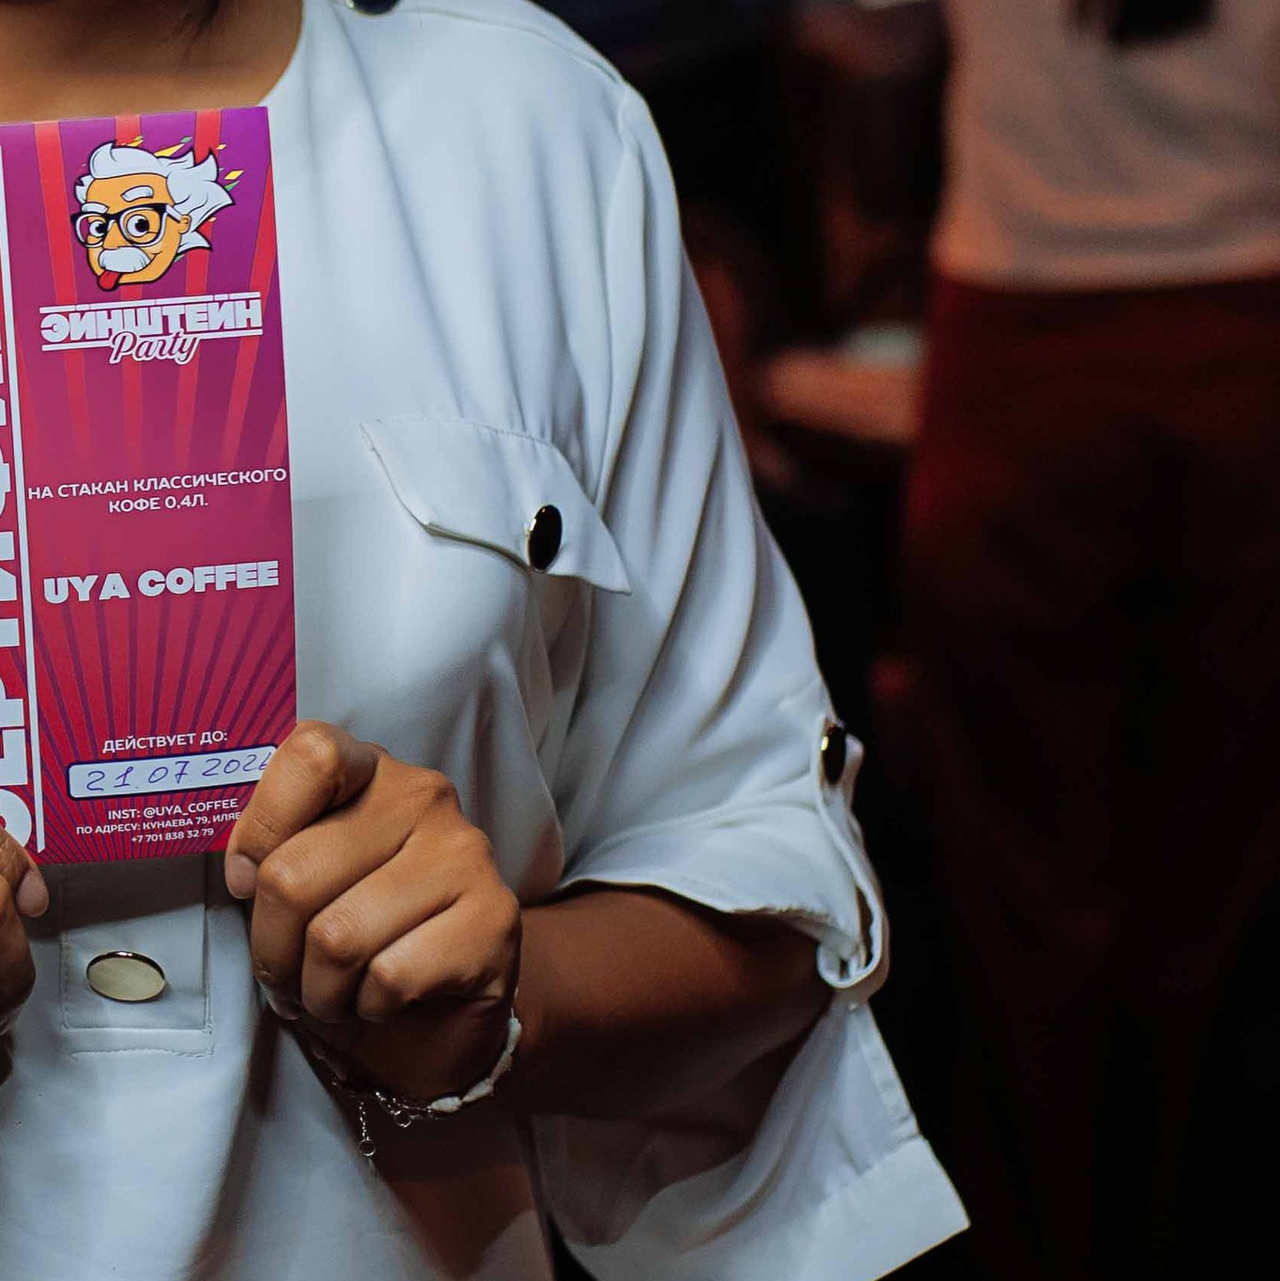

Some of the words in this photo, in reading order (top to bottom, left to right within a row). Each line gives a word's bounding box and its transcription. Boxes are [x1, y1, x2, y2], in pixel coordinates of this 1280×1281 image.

[109, 329, 202, 365] Party
[28, 486, 53, 500] НА
[57, 480, 129, 498] СТАКАН
[133, 468, 288, 492] КЛАССИЧЕСКОГО
[108, 497, 161, 513] КОФЕ
[43, 572, 131, 604] UYA
[137, 560, 279, 598] COFFEE
[102, 733, 196, 753] ДЕЙСТВУЕТ
[199, 730, 228, 745] ДО:
[108, 808, 141, 820] INST:
[143, 798, 239, 819] @UYA_COFFEE
[76, 826, 93, 835] ПО
[95, 823, 141, 834] АДРЕСУ:
[142, 817, 194, 830] КУНАЕВА
[131, 835, 144, 843] +7
[146, 833, 163, 842] 701
[165, 831, 185, 840] 838
[187, 829, 200, 838] 32
[202, 827, 215, 837] 79
